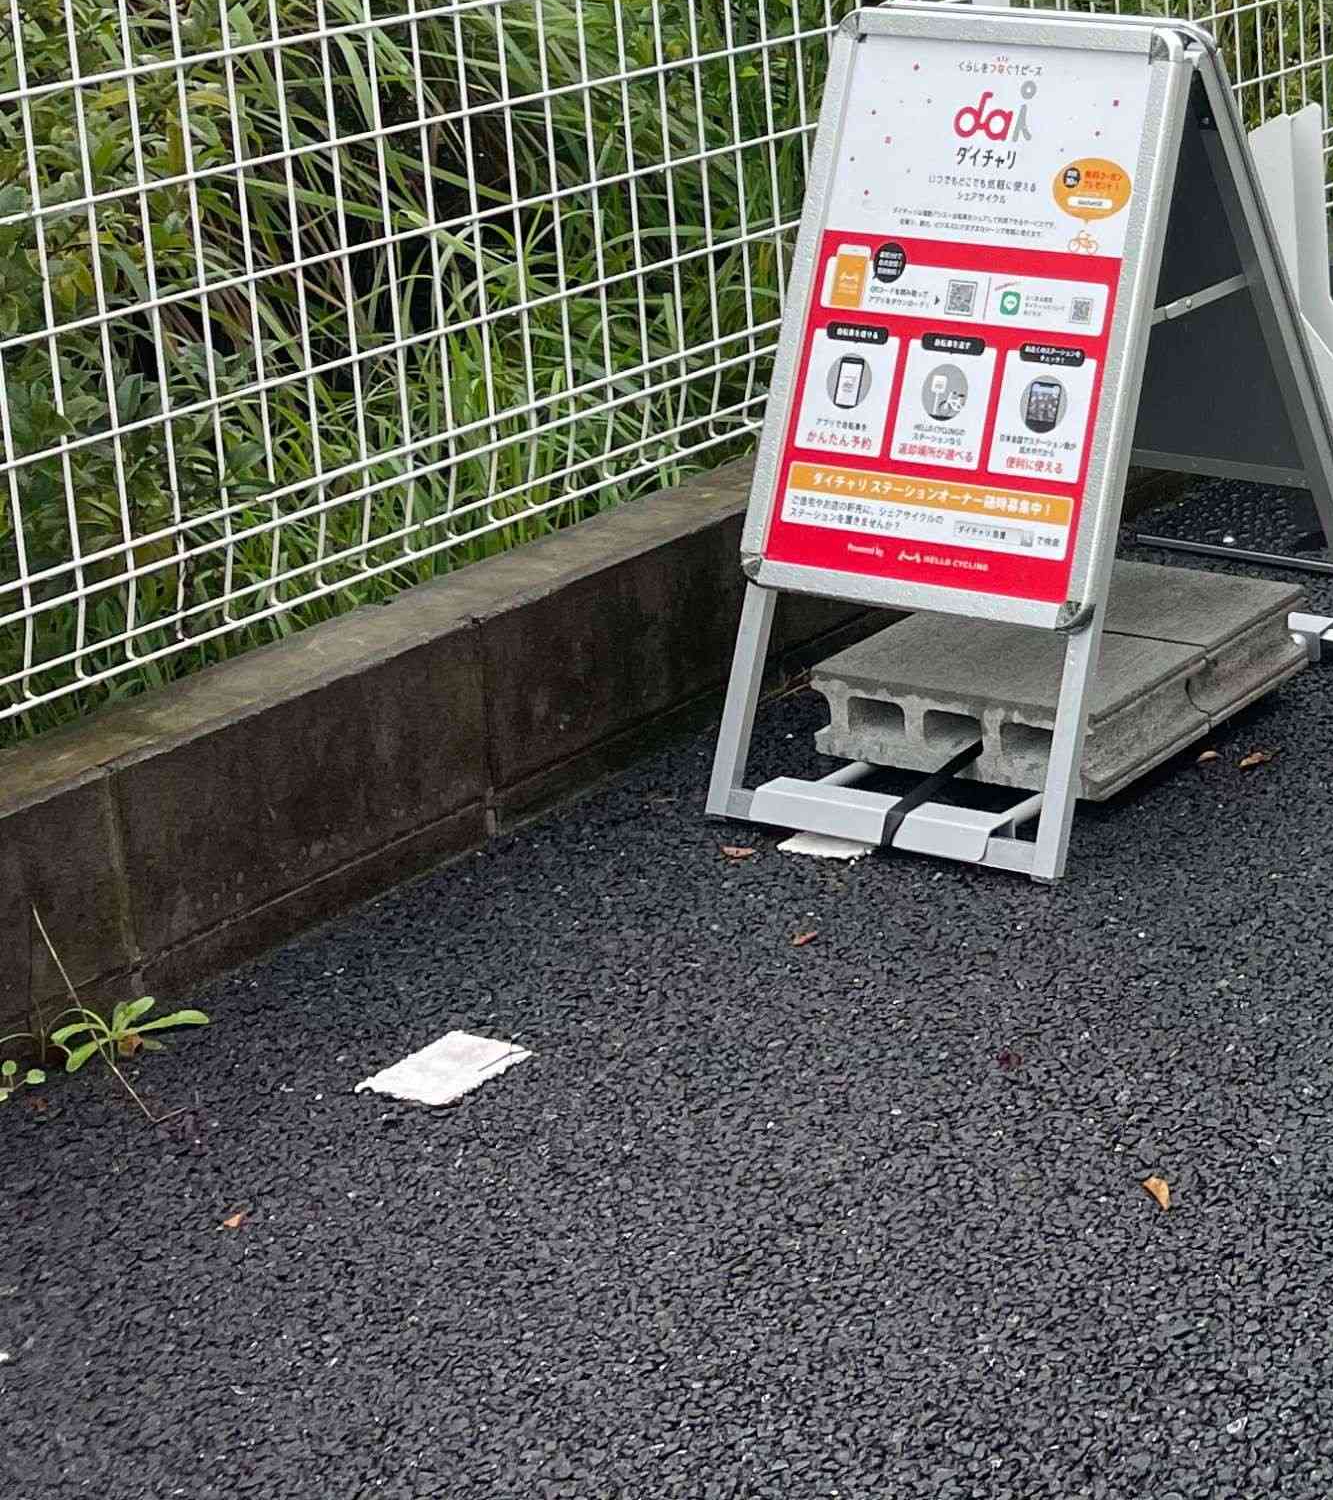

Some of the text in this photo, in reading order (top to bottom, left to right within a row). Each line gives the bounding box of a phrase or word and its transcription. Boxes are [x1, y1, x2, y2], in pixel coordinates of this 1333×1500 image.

[956, 146, 1018, 170] ダイチャリ
[806, 431, 872, 451] かんたん予約
[1006, 457, 1064, 475] 便利に使える
[923, 555, 989, 572] HELLO CYCLING
